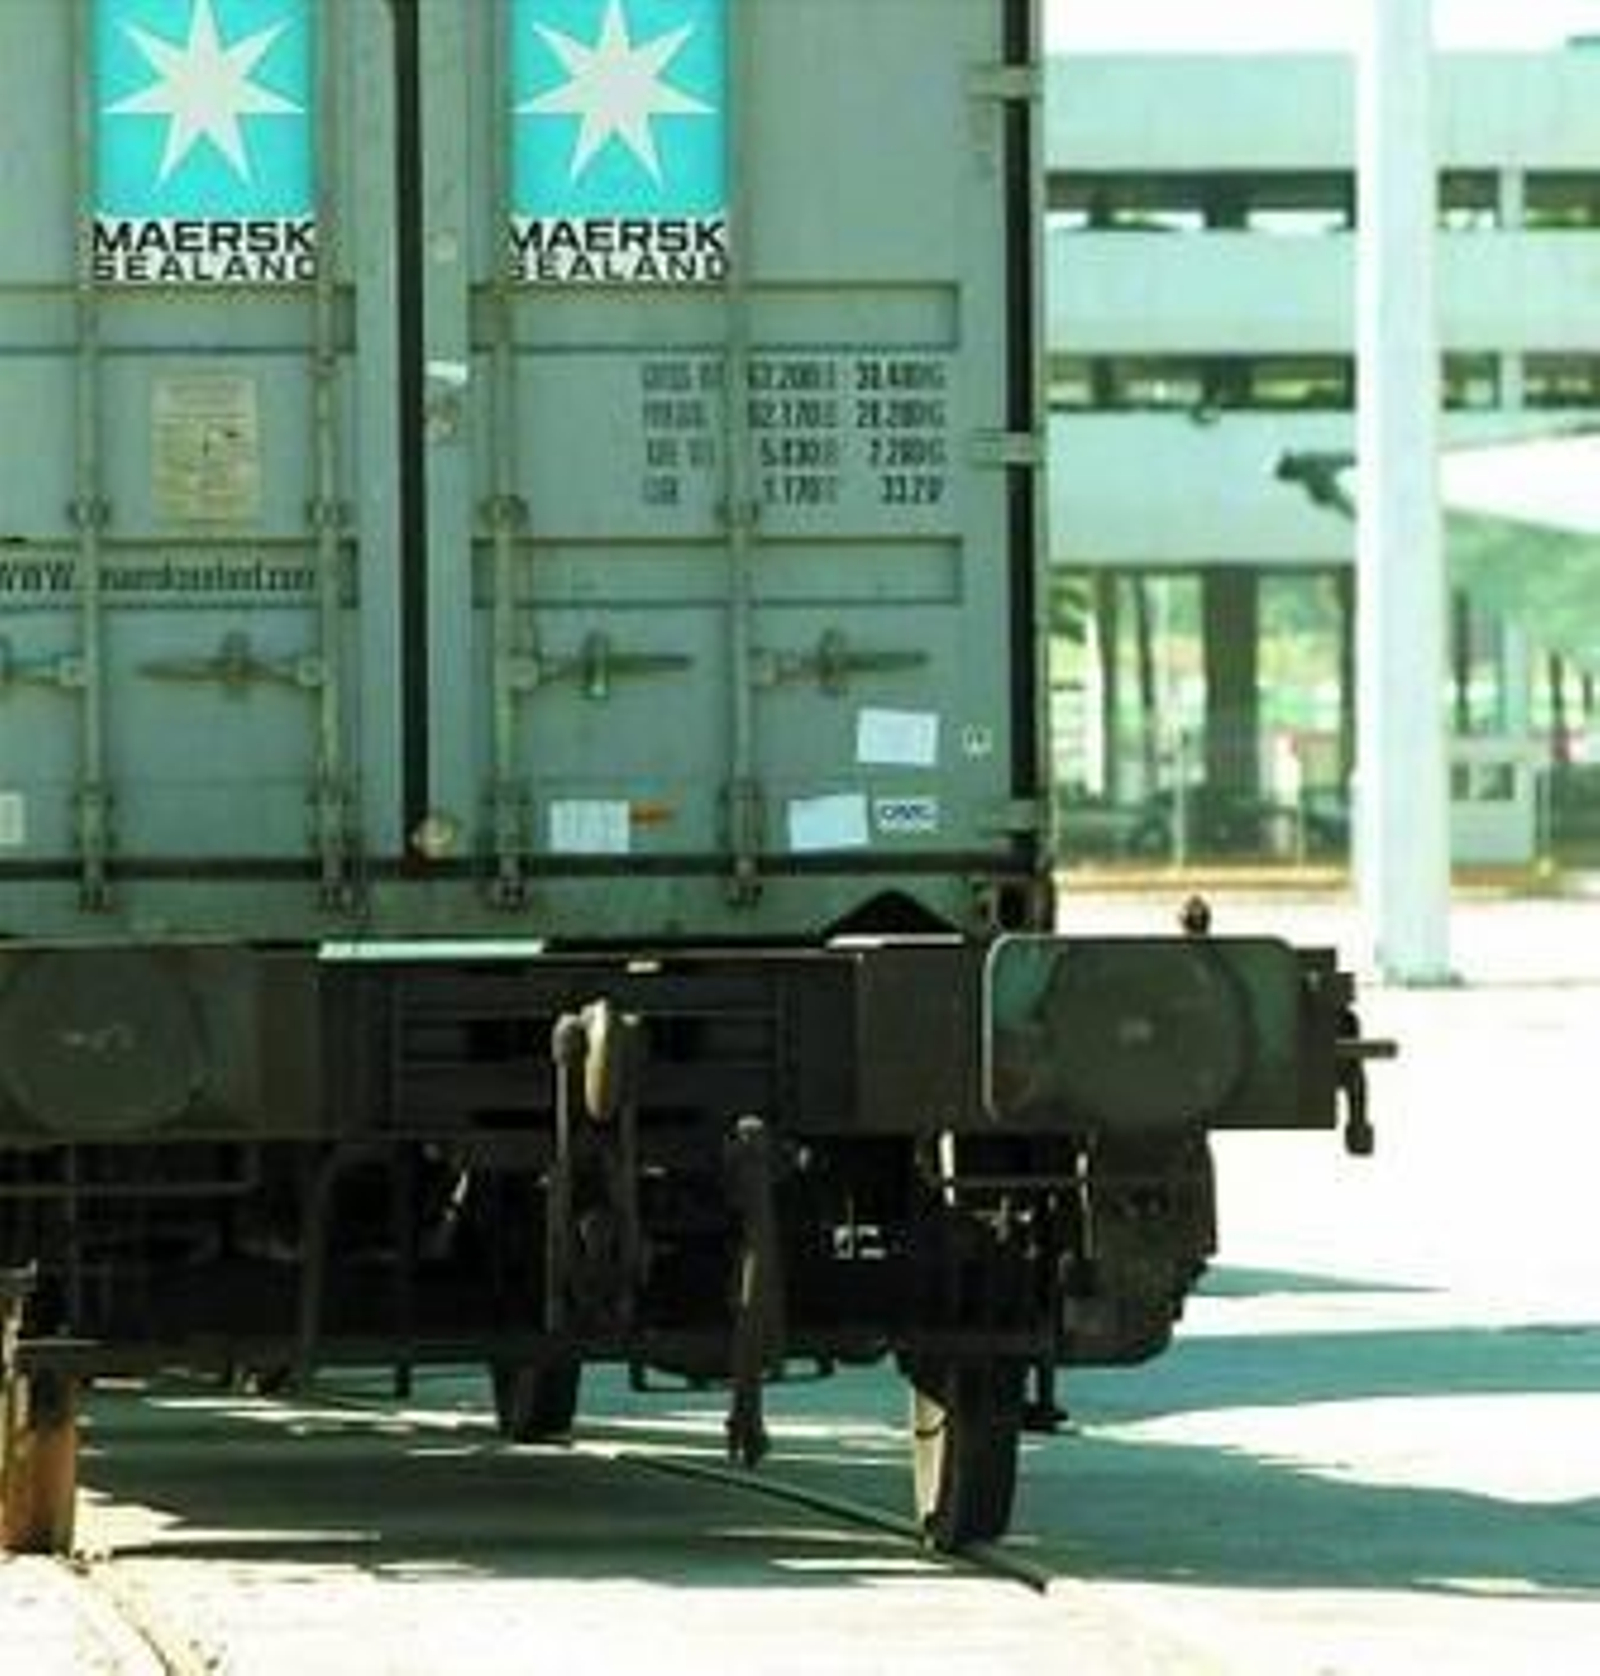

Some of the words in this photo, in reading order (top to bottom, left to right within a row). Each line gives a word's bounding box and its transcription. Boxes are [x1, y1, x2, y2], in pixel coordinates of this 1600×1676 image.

[93, 221, 316, 252] MAERSK
[506, 221, 724, 252] MAERSK
[93, 254, 318, 280] SEALAND
[508, 254, 728, 280] SEALAND
